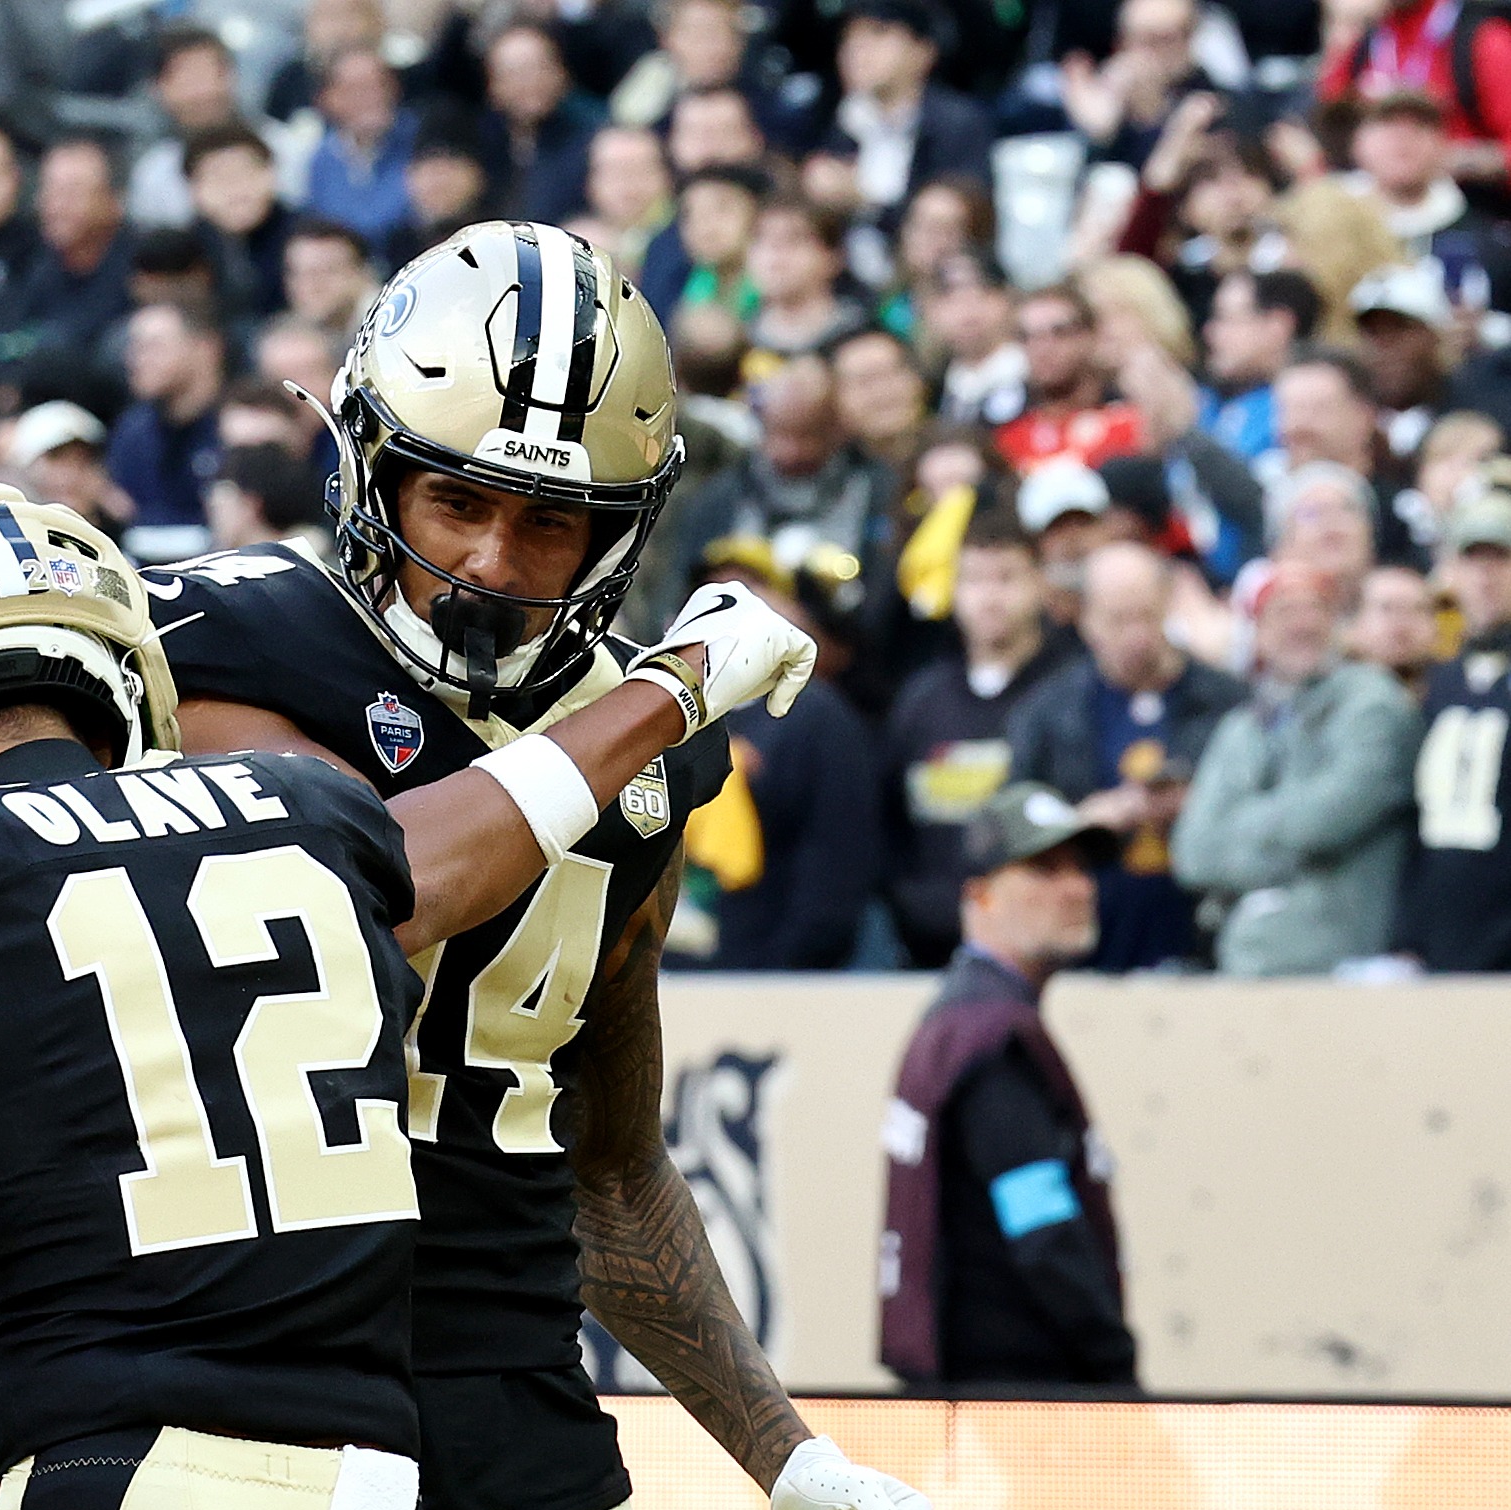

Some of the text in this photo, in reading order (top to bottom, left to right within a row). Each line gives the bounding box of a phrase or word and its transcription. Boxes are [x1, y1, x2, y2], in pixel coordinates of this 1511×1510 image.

[503, 440, 571, 467] SAINTS
[21, 559, 49, 590] 2
[380, 725, 412, 739] PARIS
[1, 763, 289, 846] OLAVE
[624, 784, 665, 820] 60
[46, 844, 421, 1257] 12
